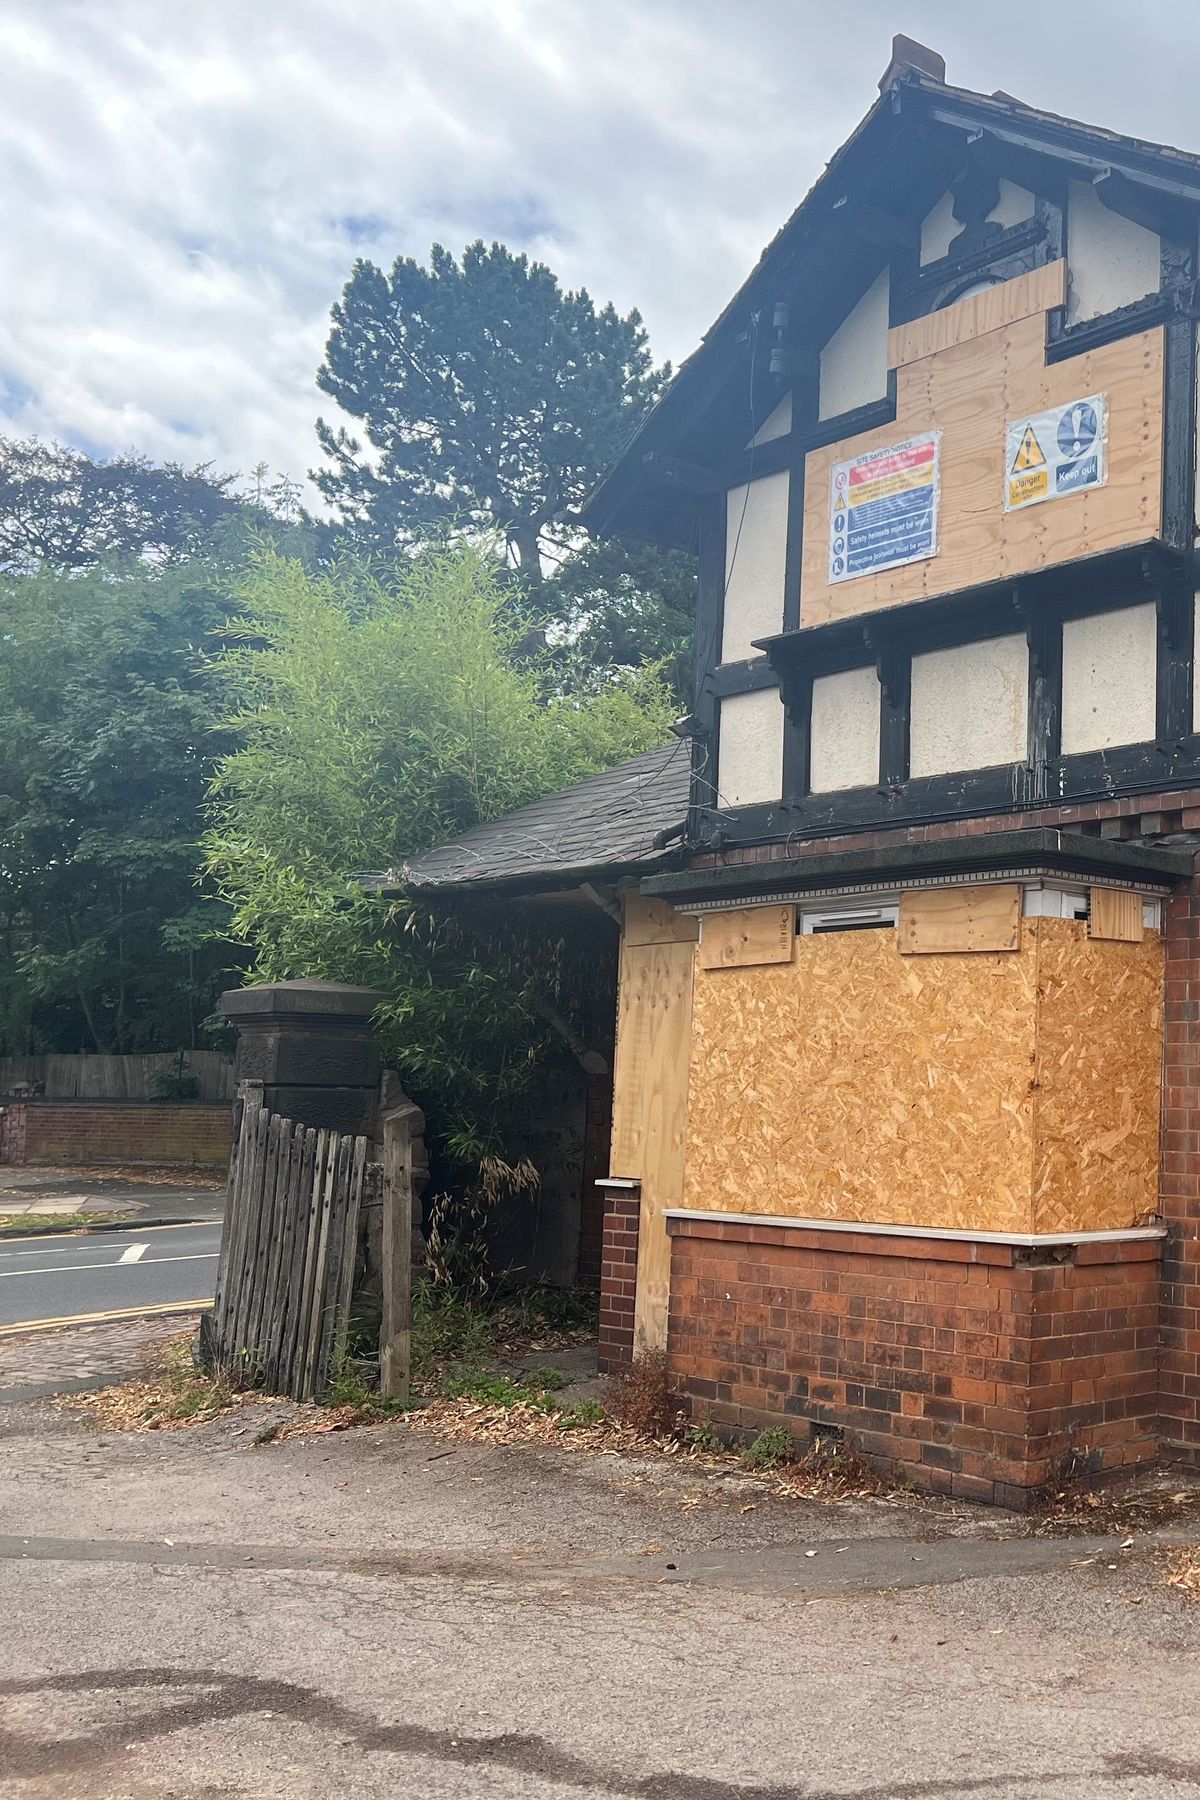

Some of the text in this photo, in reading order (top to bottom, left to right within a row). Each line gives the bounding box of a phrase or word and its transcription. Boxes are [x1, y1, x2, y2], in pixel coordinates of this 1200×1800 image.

[856, 442, 913, 465] SITE SAFETY NOTICE
[1015, 475, 1041, 489] Danger
[1059, 464, 1096, 481] Keep out
[850, 535, 867, 545] Safety
[868, 528, 890, 540] helmets
[890, 523, 905, 534] must
[905, 521, 914, 529] be
[849, 555, 873, 567] Protective
[873, 548, 895, 562] footwear
[895, 544, 909, 554] must
[909, 542, 917, 550] be
